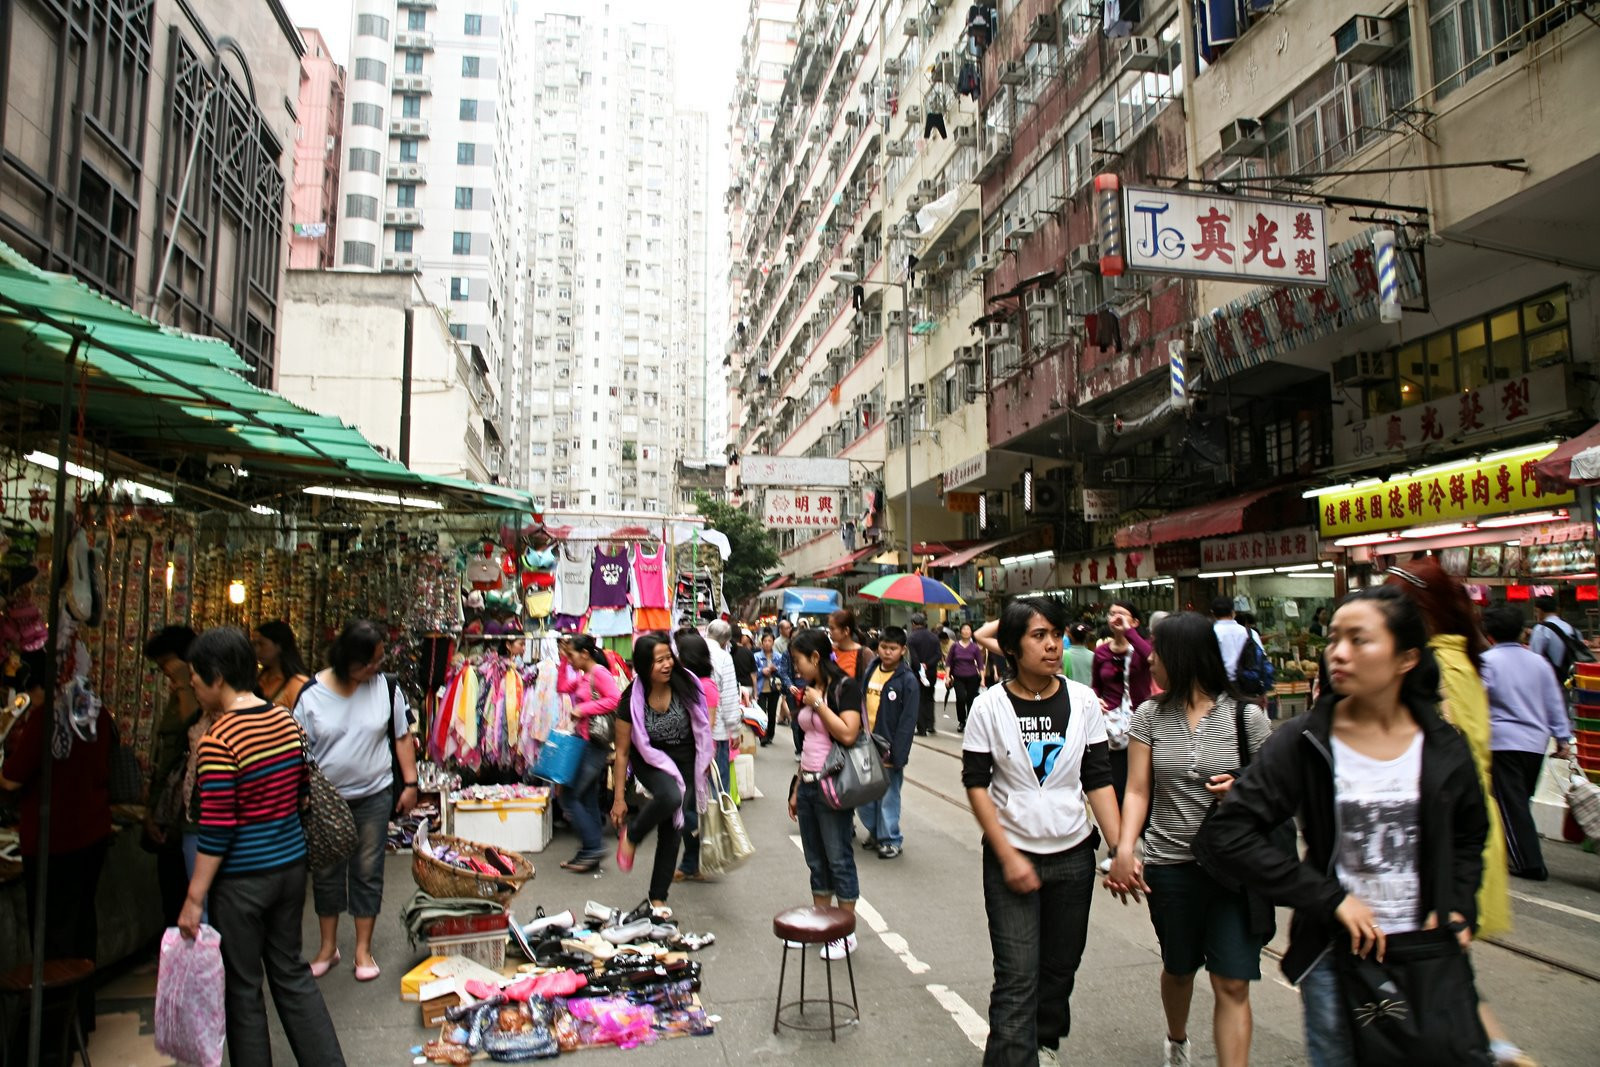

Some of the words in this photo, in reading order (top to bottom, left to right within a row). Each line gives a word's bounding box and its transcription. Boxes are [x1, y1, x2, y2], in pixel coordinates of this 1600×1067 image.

[1190, 206, 1287, 269] 真光
[1292, 211, 1317, 276] 髮型
[1383, 376, 1531, 450] 真光髮型
[795, 495, 833, 513] 明興
[1039, 717, 1052, 731] TO
[1041, 732, 1060, 742] ROCK
